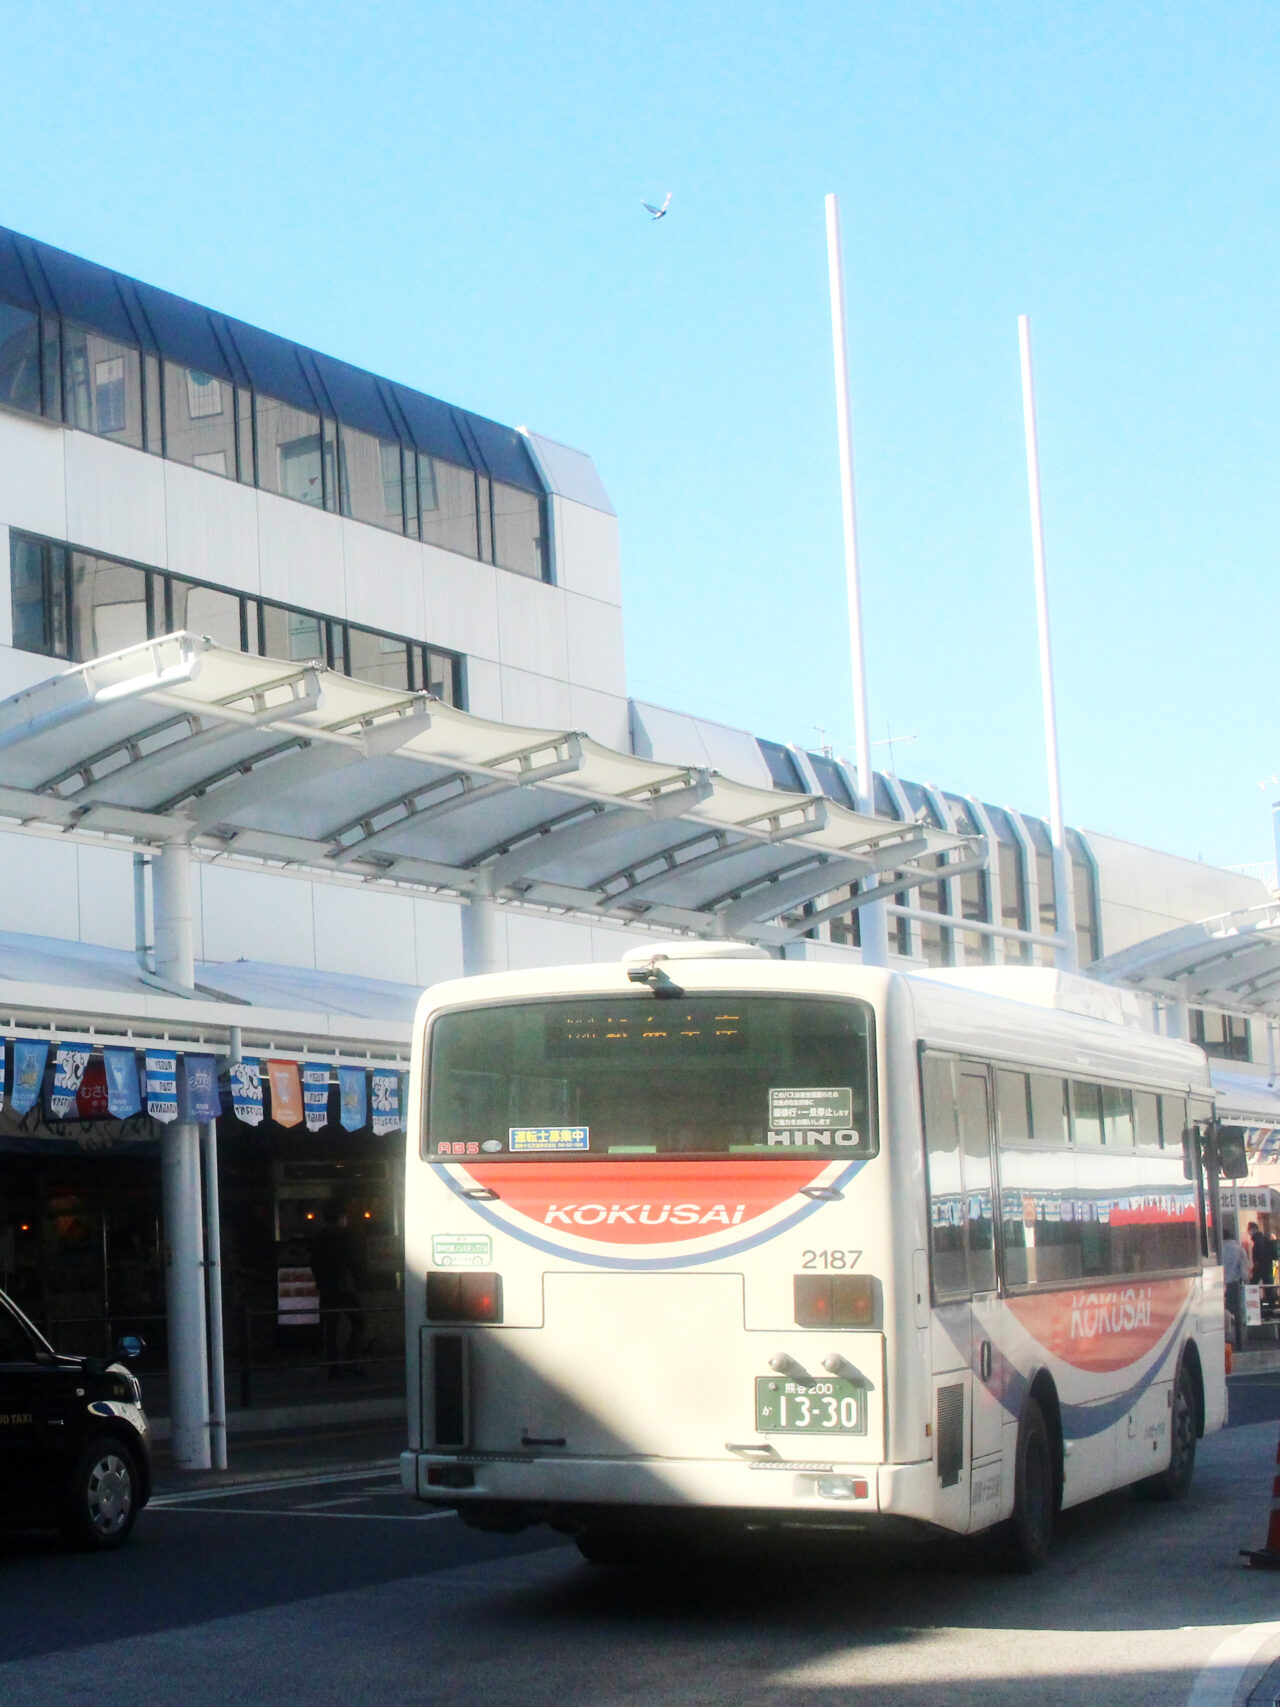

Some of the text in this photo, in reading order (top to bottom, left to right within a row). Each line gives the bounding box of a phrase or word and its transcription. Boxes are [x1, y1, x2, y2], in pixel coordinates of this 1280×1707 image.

[515, 1129, 584, 1143] 運転士募集中
[767, 1130, 859, 1145] HINO
[437, 1142, 479, 1155] ABS
[543, 1204, 746, 1225] KOKUSAI
[802, 1249, 864, 1269] 2187
[1070, 1287, 1152, 1338] KOKUSAI
[784, 1383, 833, 1395] 熊谷200
[11, 1412, 33, 1424] TAXI
[761, 1405, 773, 1417] か
[779, 1395, 858, 1428] 13-30
